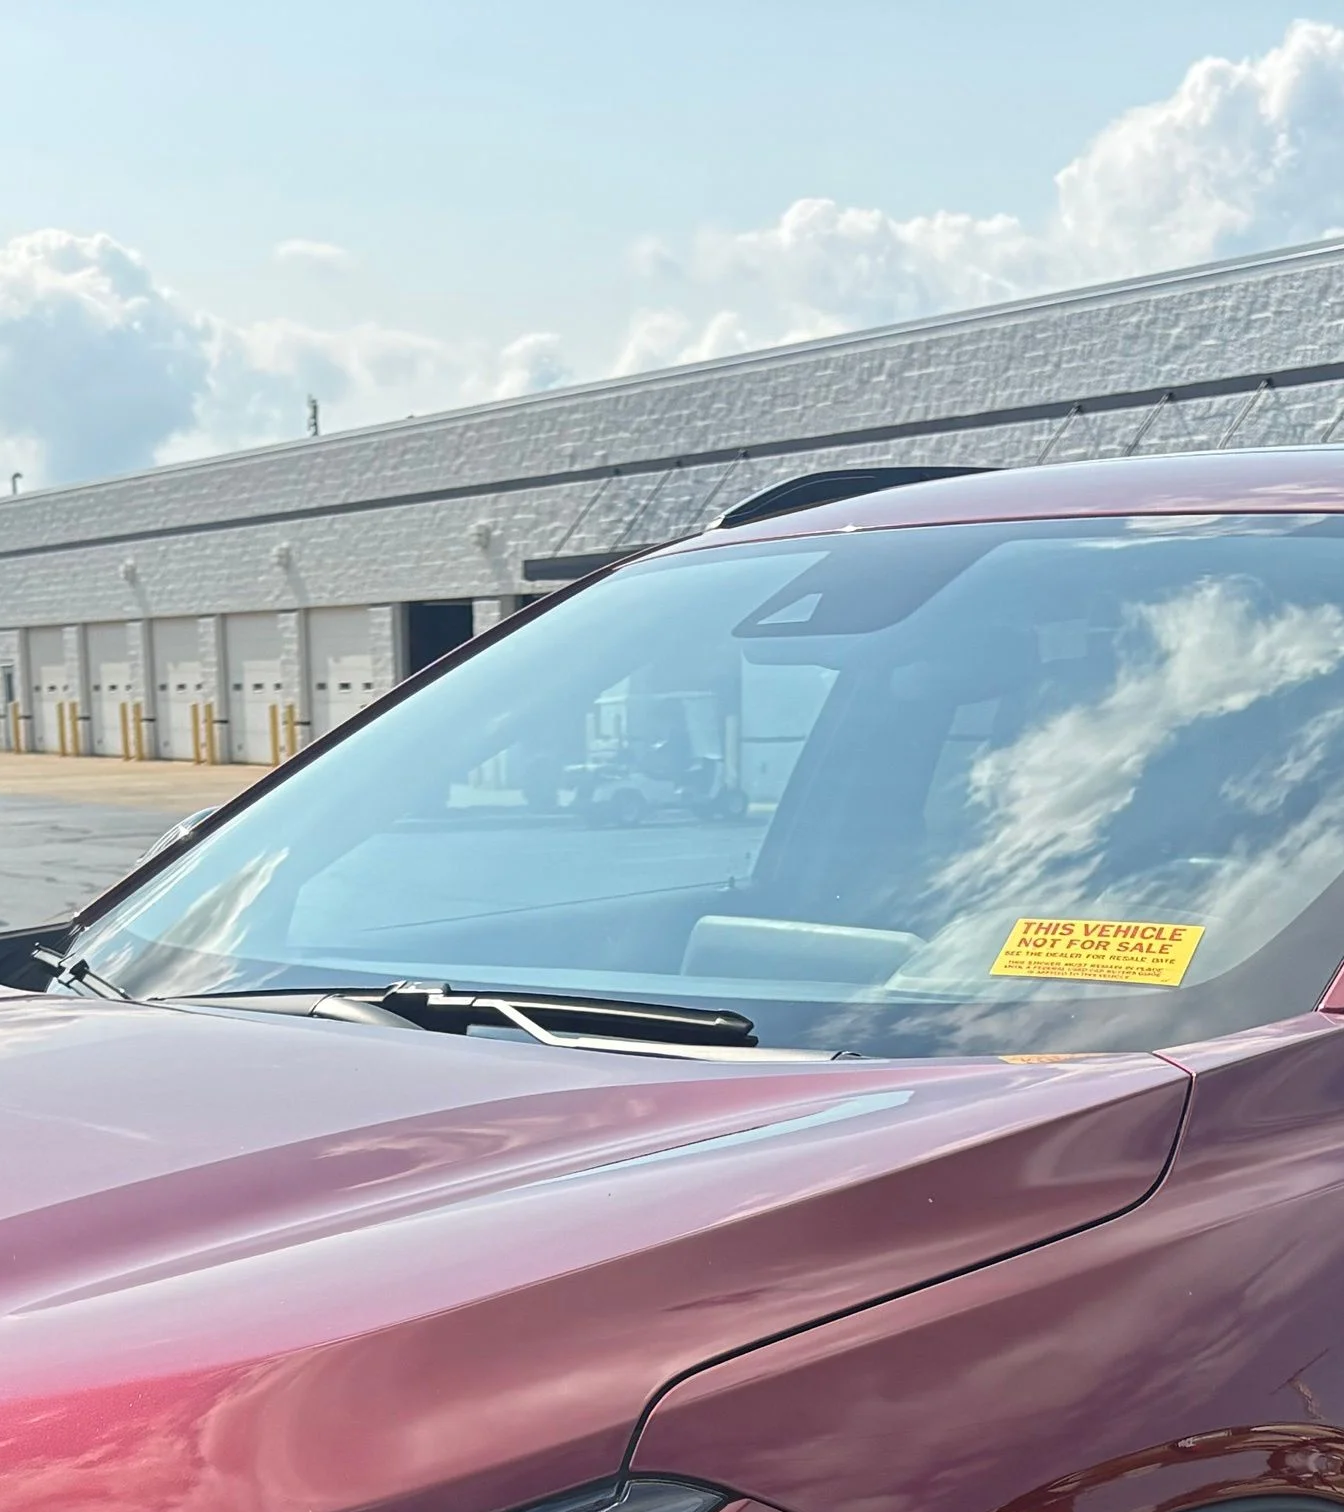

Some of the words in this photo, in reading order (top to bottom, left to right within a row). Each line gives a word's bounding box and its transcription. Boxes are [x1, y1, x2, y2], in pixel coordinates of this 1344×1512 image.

[1022, 921, 1076, 937] THIS
[1083, 923, 1187, 942] VEHICLE
[1016, 936, 1062, 949] NOT
[1065, 938, 1112, 952] FOR
[1116, 941, 1173, 955] SALE
[1025, 950, 1044, 958] THE
[1045, 951, 1083, 959] DEALER
[1108, 954, 1148, 963] RESALE
